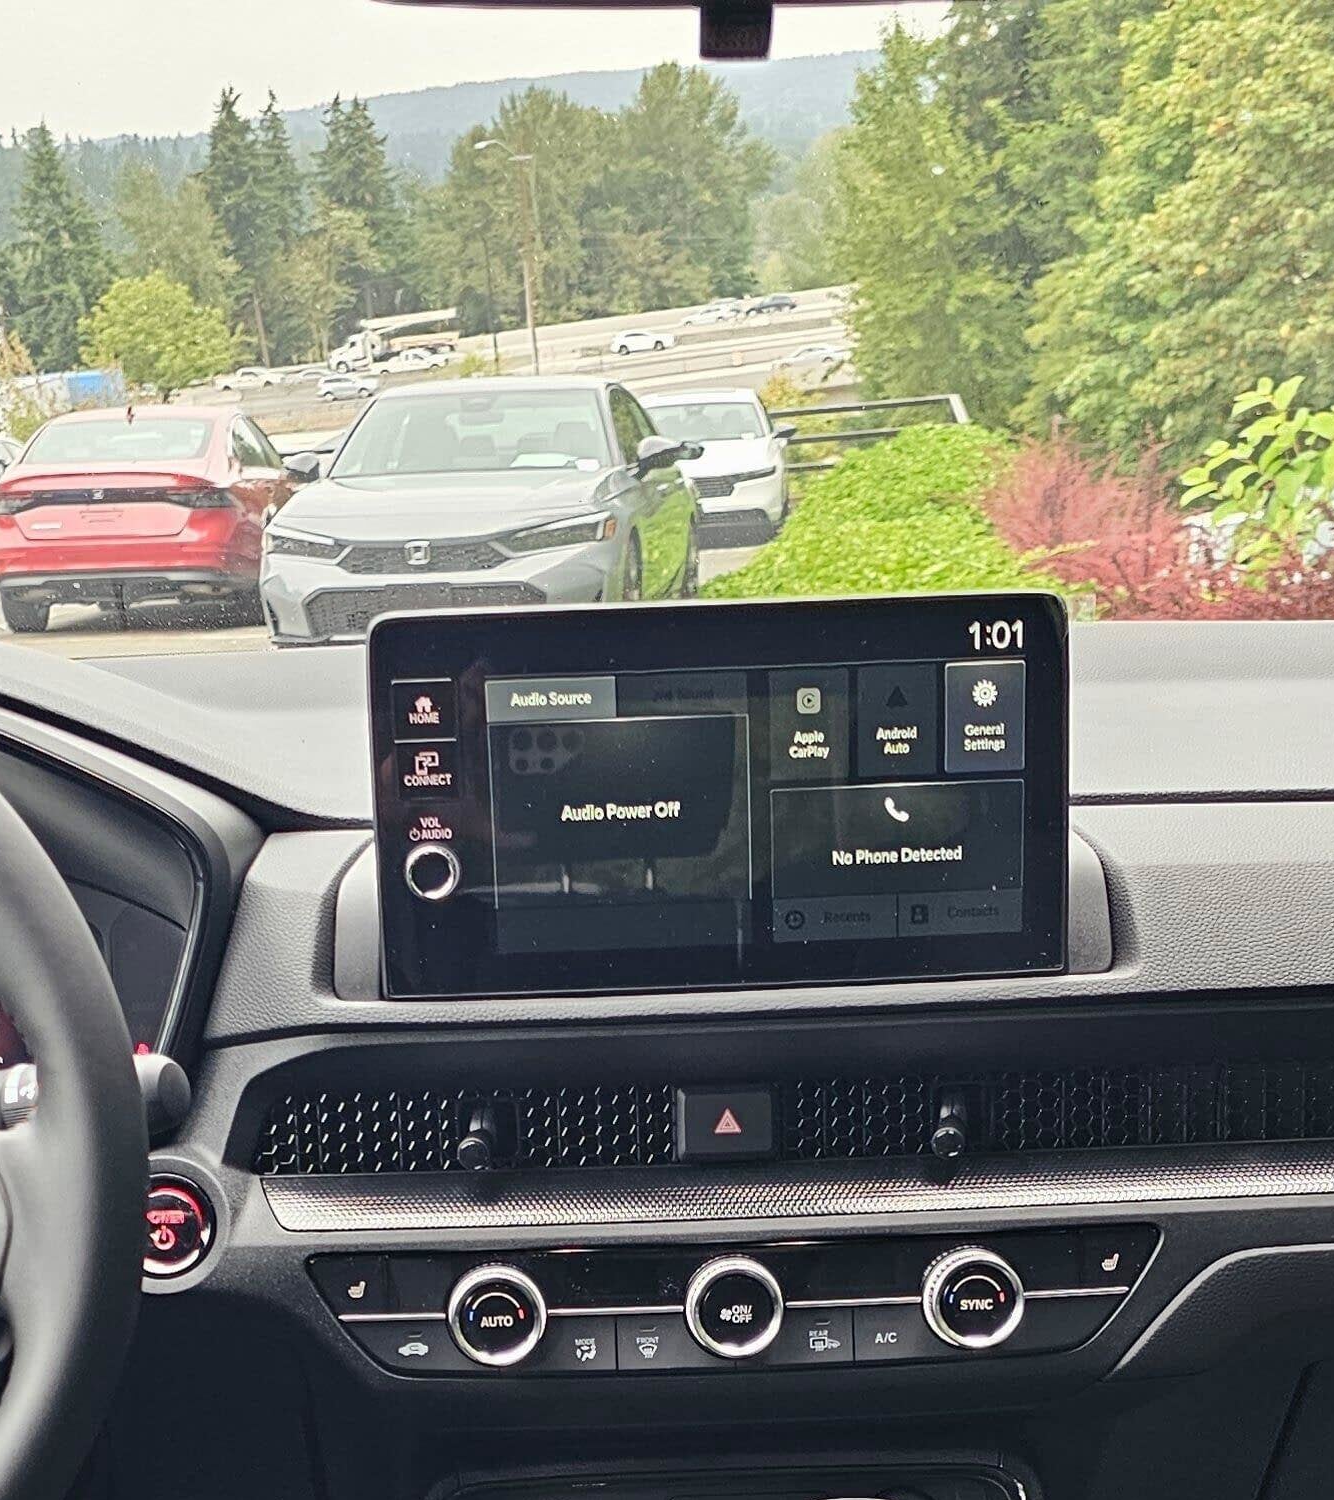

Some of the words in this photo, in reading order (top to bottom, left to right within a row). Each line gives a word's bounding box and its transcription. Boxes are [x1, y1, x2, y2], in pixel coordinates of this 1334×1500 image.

[968, 619, 1024, 650] 1:01
[511, 692, 548, 707] Audio
[548, 691, 592, 705] Source
[408, 712, 440, 724] HOME
[876, 726, 918, 740] Android
[964, 723, 1005, 736] General
[793, 730, 825, 745] Apple
[884, 741, 910, 754] Auto
[964, 737, 1006, 752] Settings
[789, 745, 830, 760] CarPlay
[404, 774, 452, 786] CONNECT
[560, 804, 605, 821] Audio
[606, 803, 652, 820] Power
[654, 801, 681, 818] Off
[420, 817, 442, 828] VOL
[421, 827, 452, 840] AUDIO
[832, 850, 853, 866] No
[855, 849, 898, 864] Phone
[901, 846, 963, 862] Detected
[947, 904, 1000, 919] Contacts
[732, 1304, 752, 1315] ON/
[960, 1299, 994, 1311] SYNC
[480, 1315, 514, 1328] AUTO
[732, 1314, 753, 1324] OFF
[636, 1336, 659, 1344] FRONT
[808, 1330, 829, 1338] REAR
[875, 1332, 897, 1343] A/C
[575, 1338, 595, 1346] MODE
